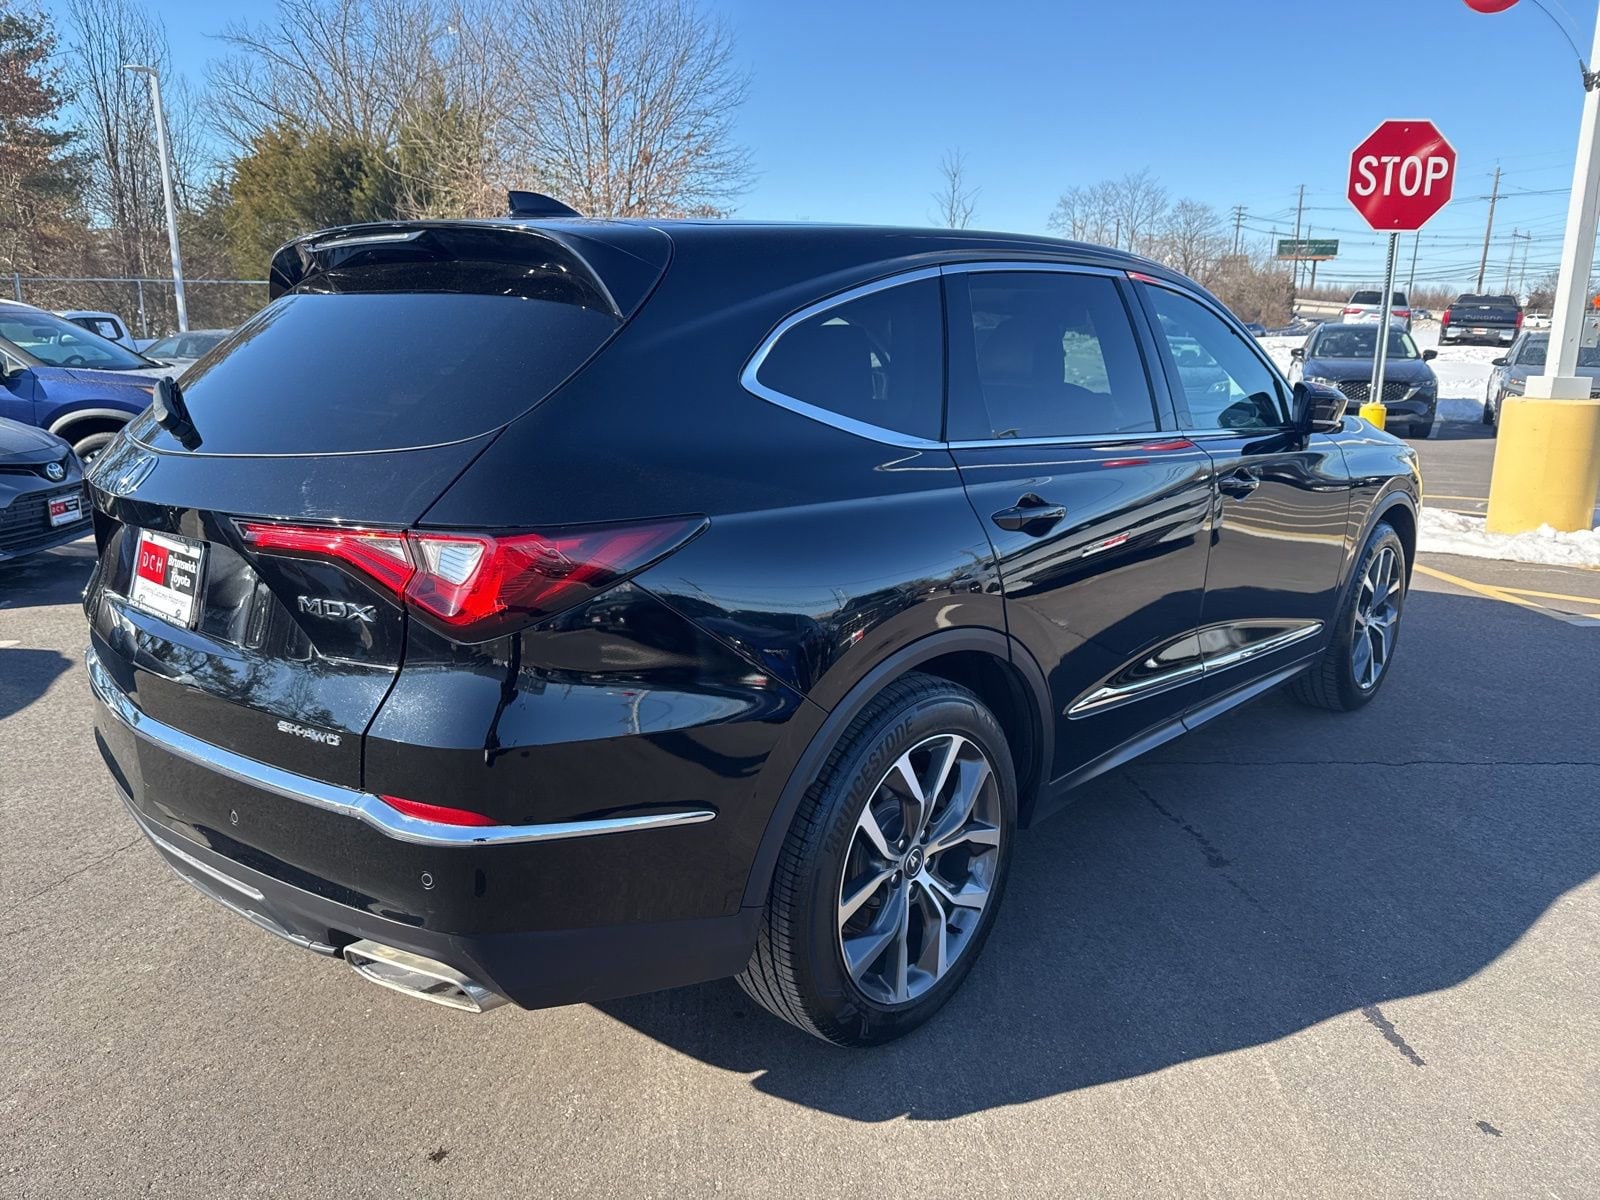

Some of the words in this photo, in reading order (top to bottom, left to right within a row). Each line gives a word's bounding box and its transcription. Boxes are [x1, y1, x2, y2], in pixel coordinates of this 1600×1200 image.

[1354, 155, 1449, 197] STOP
[142, 551, 164, 574] DCH
[167, 555, 197, 574] Brunswick
[171, 570, 191, 588] Toyota
[297, 595, 377, 623] MDX
